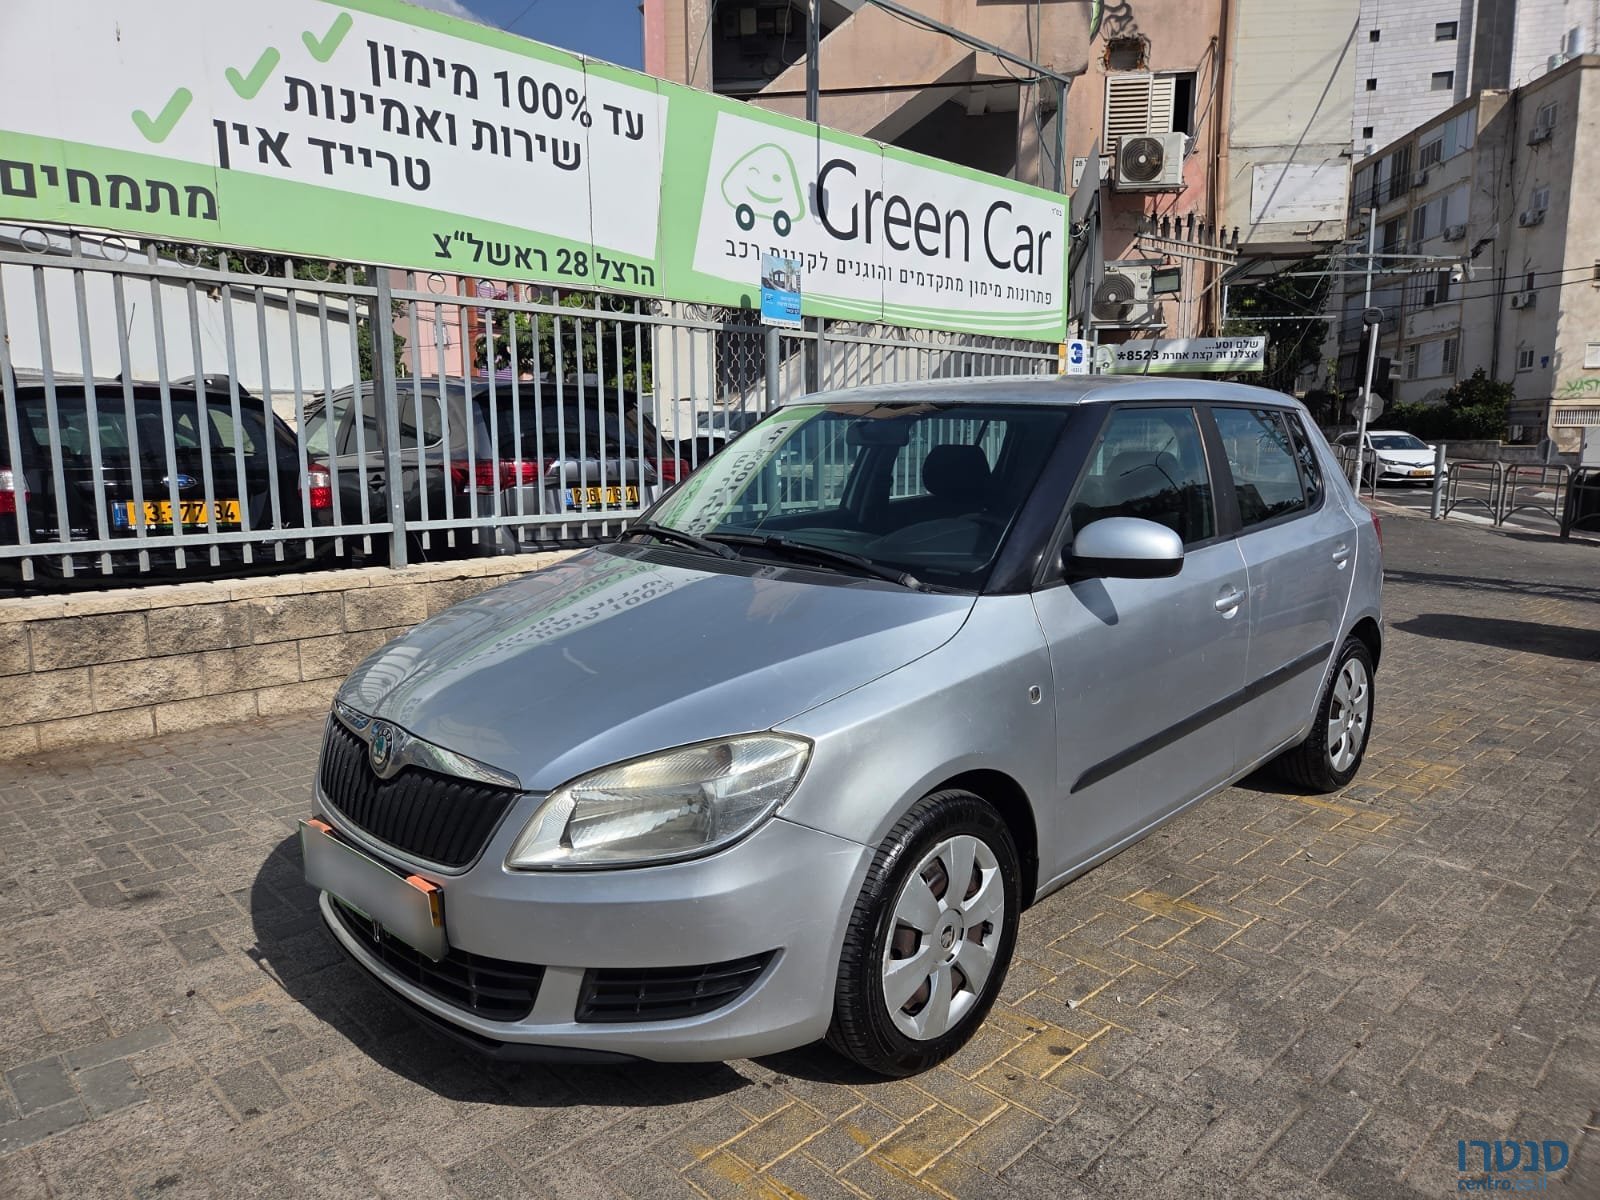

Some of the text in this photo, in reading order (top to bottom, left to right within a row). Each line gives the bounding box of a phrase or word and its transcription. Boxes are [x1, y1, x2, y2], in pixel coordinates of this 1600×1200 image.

[366, 39, 644, 140] עד 100% מימון
[284, 75, 581, 171] שירות ואמינות
[213, 119, 431, 191] טרייד אין
[0, 159, 217, 221] מתמחים
[816, 158, 1052, 275] Green Car
[725, 239, 760, 261] רכב
[556, 248, 589, 278] 28
[596, 252, 655, 287] הרצל
[836, 258, 892, 282] והוגנים
[899, 268, 964, 293] מתקדמים
[969, 280, 1002, 298] מימון
[1006, 285, 1052, 305] פתרונות
[1162, 351, 1189, 360] אחרת
[1192, 350, 1213, 361] קצת
[1216, 350, 1227, 359] זה
[1230, 350, 1259, 359] אצלנו
[1236, 339, 1259, 348] שלם
